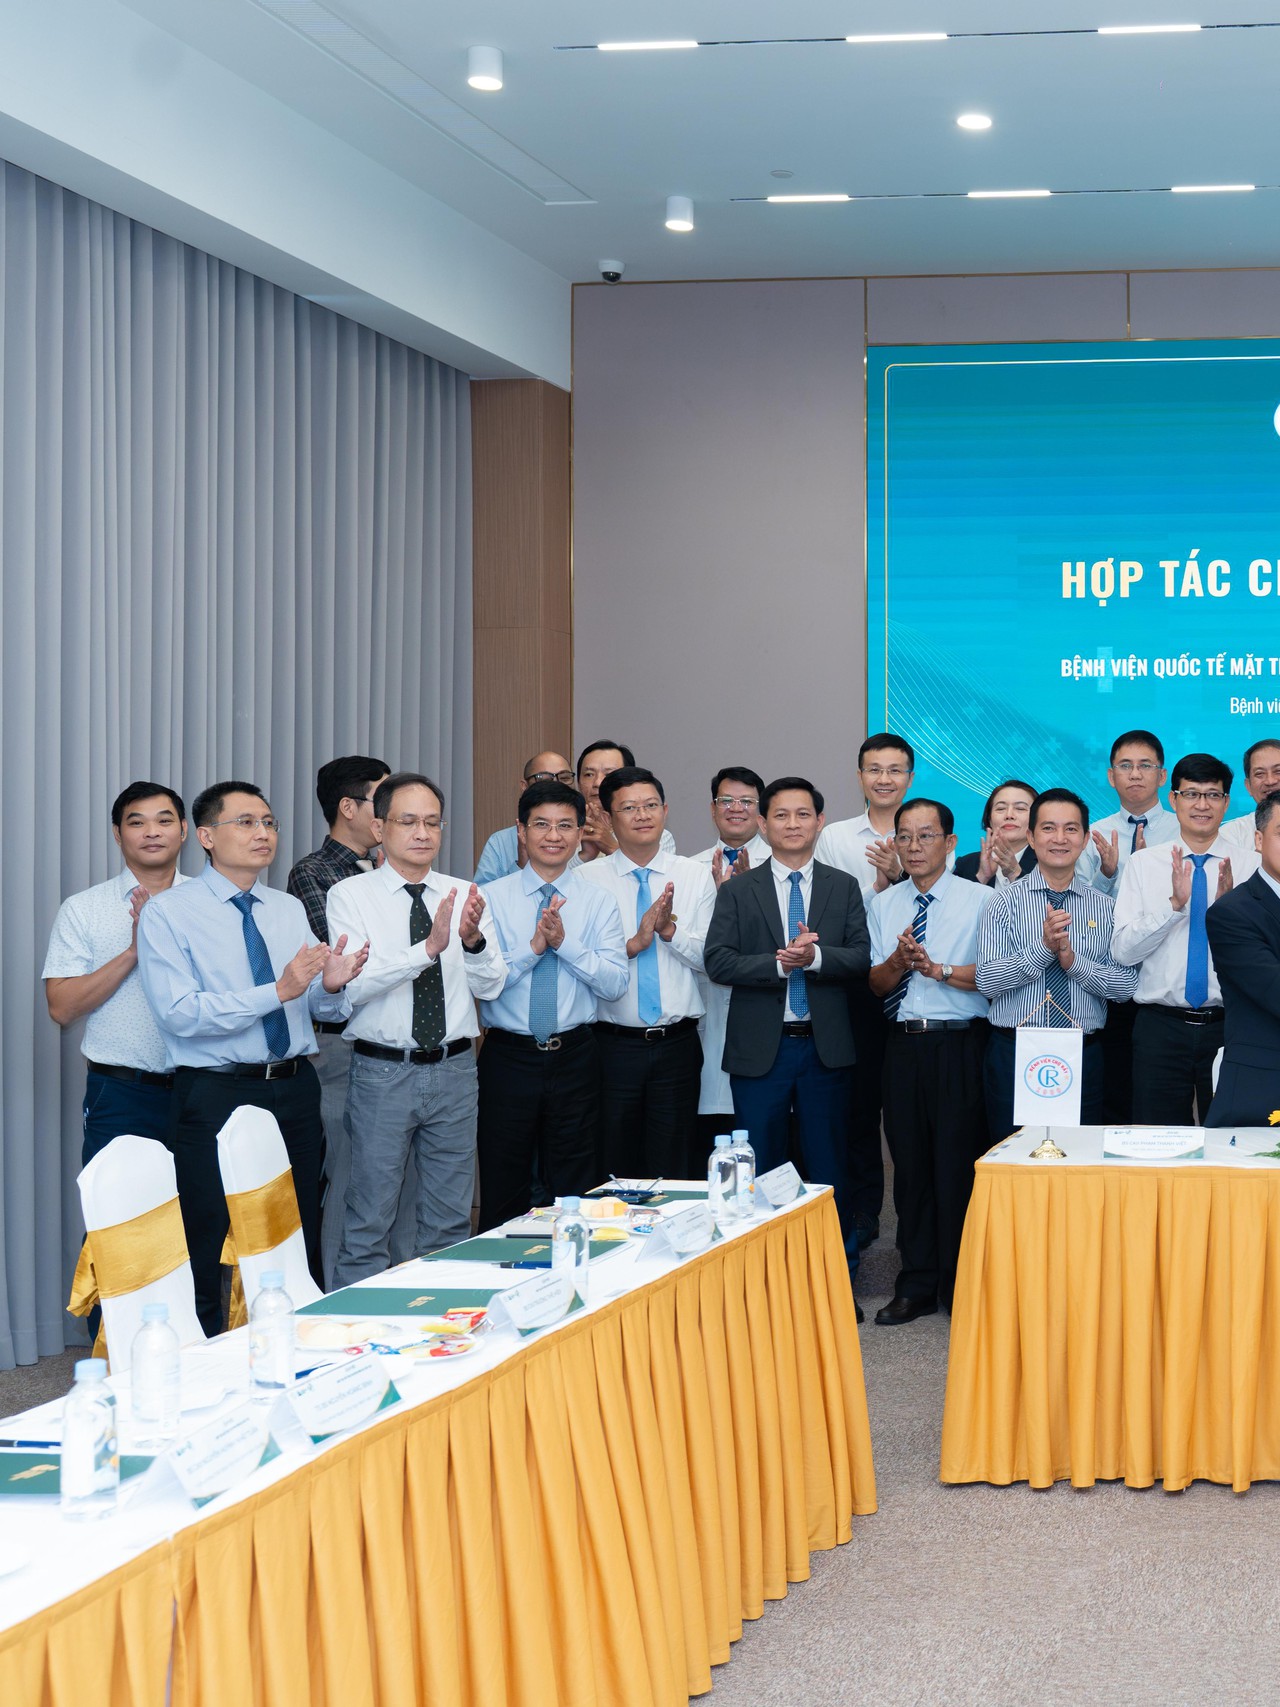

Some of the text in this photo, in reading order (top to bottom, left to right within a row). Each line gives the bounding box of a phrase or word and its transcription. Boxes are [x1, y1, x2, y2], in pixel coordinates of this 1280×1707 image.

[1062, 557, 1144, 607] HỢP
[1159, 549, 1231, 598] TÁC
[1061, 655, 1105, 681] BỆNH
[1111, 654, 1148, 680] VIỆN
[1153, 652, 1201, 678] QUỐC
[1206, 651, 1227, 676] TẾ
[1230, 653, 1264, 680] MẶT
[1230, 697, 1263, 716] Bệnh
